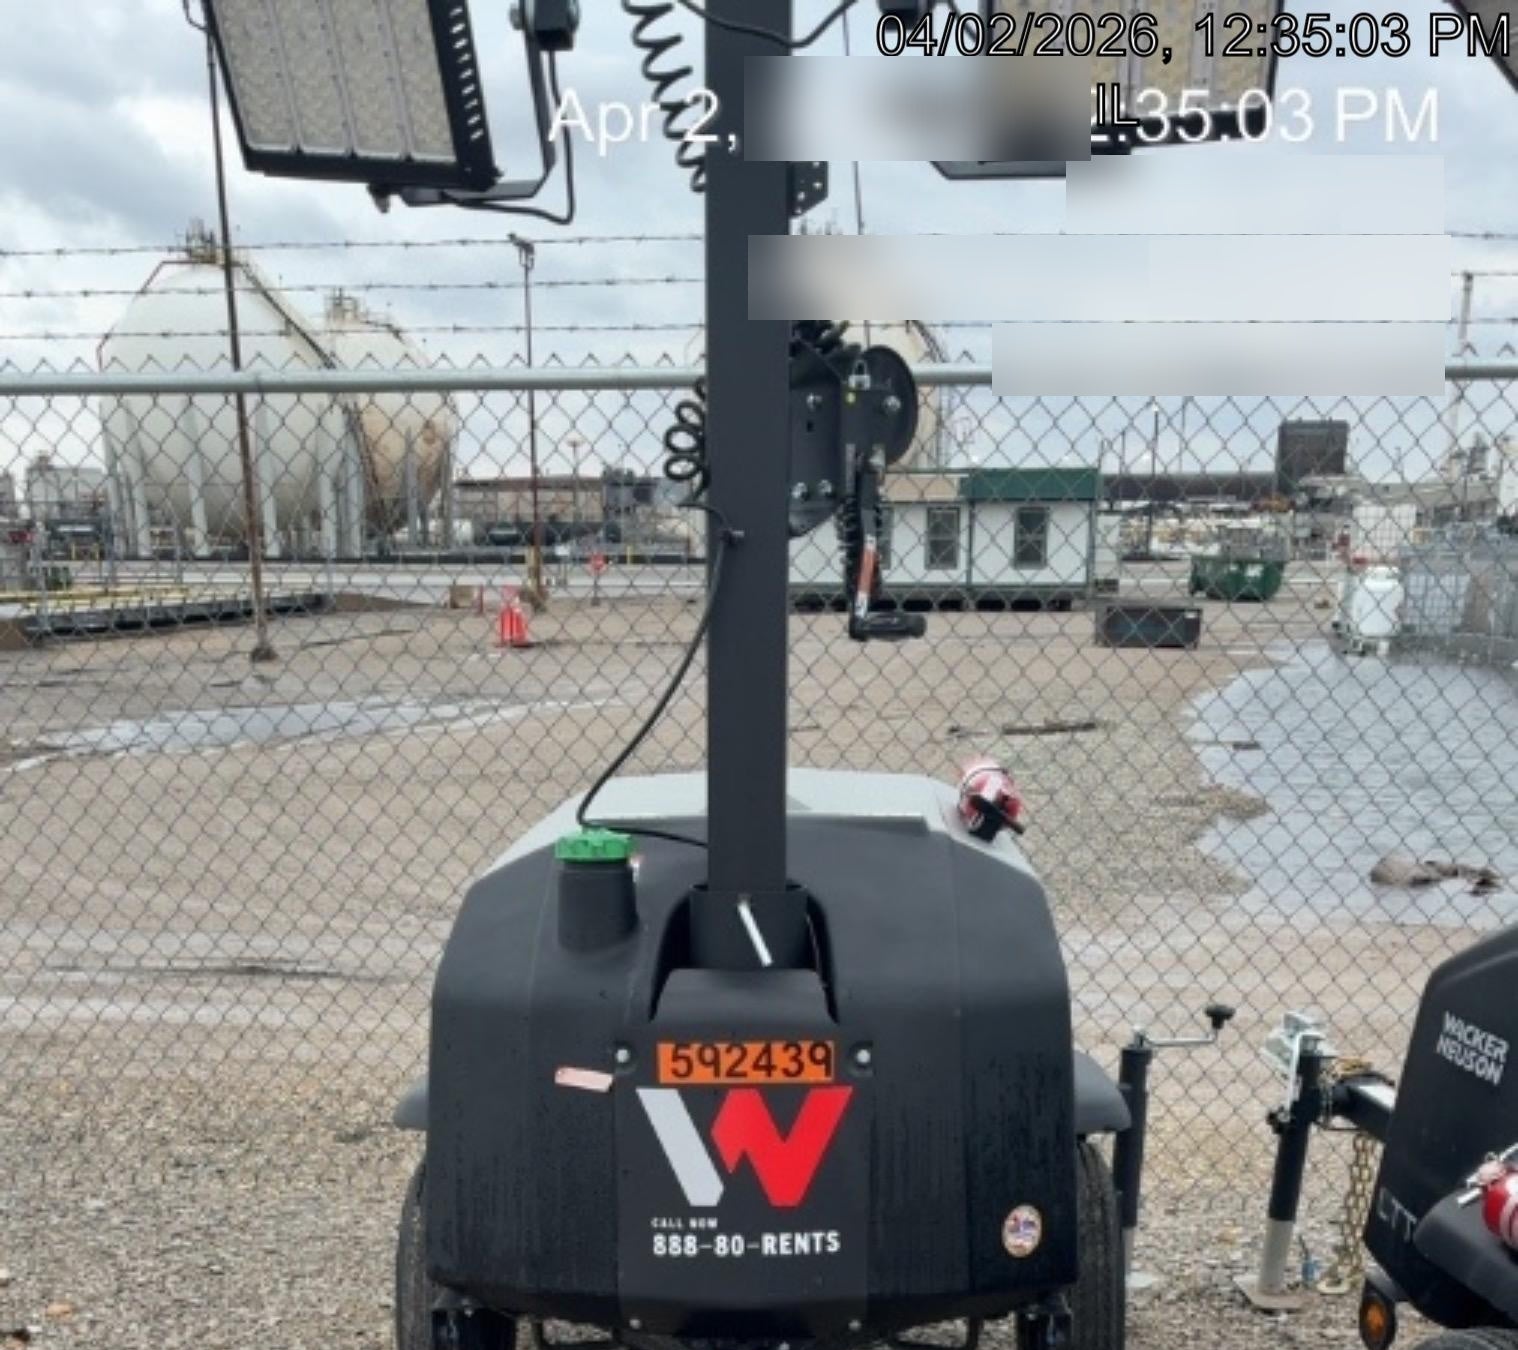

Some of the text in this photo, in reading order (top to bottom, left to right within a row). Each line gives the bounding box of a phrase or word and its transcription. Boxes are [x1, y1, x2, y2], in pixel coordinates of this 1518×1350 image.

[1442, 1011, 1509, 1062] WACKER
[671, 1042, 833, 1078] 592439
[1436, 1034, 1503, 1086] NEUSON
[651, 1217, 719, 1229] CALL NOW
[652, 1229, 842, 1257] 888-80-RENTS
